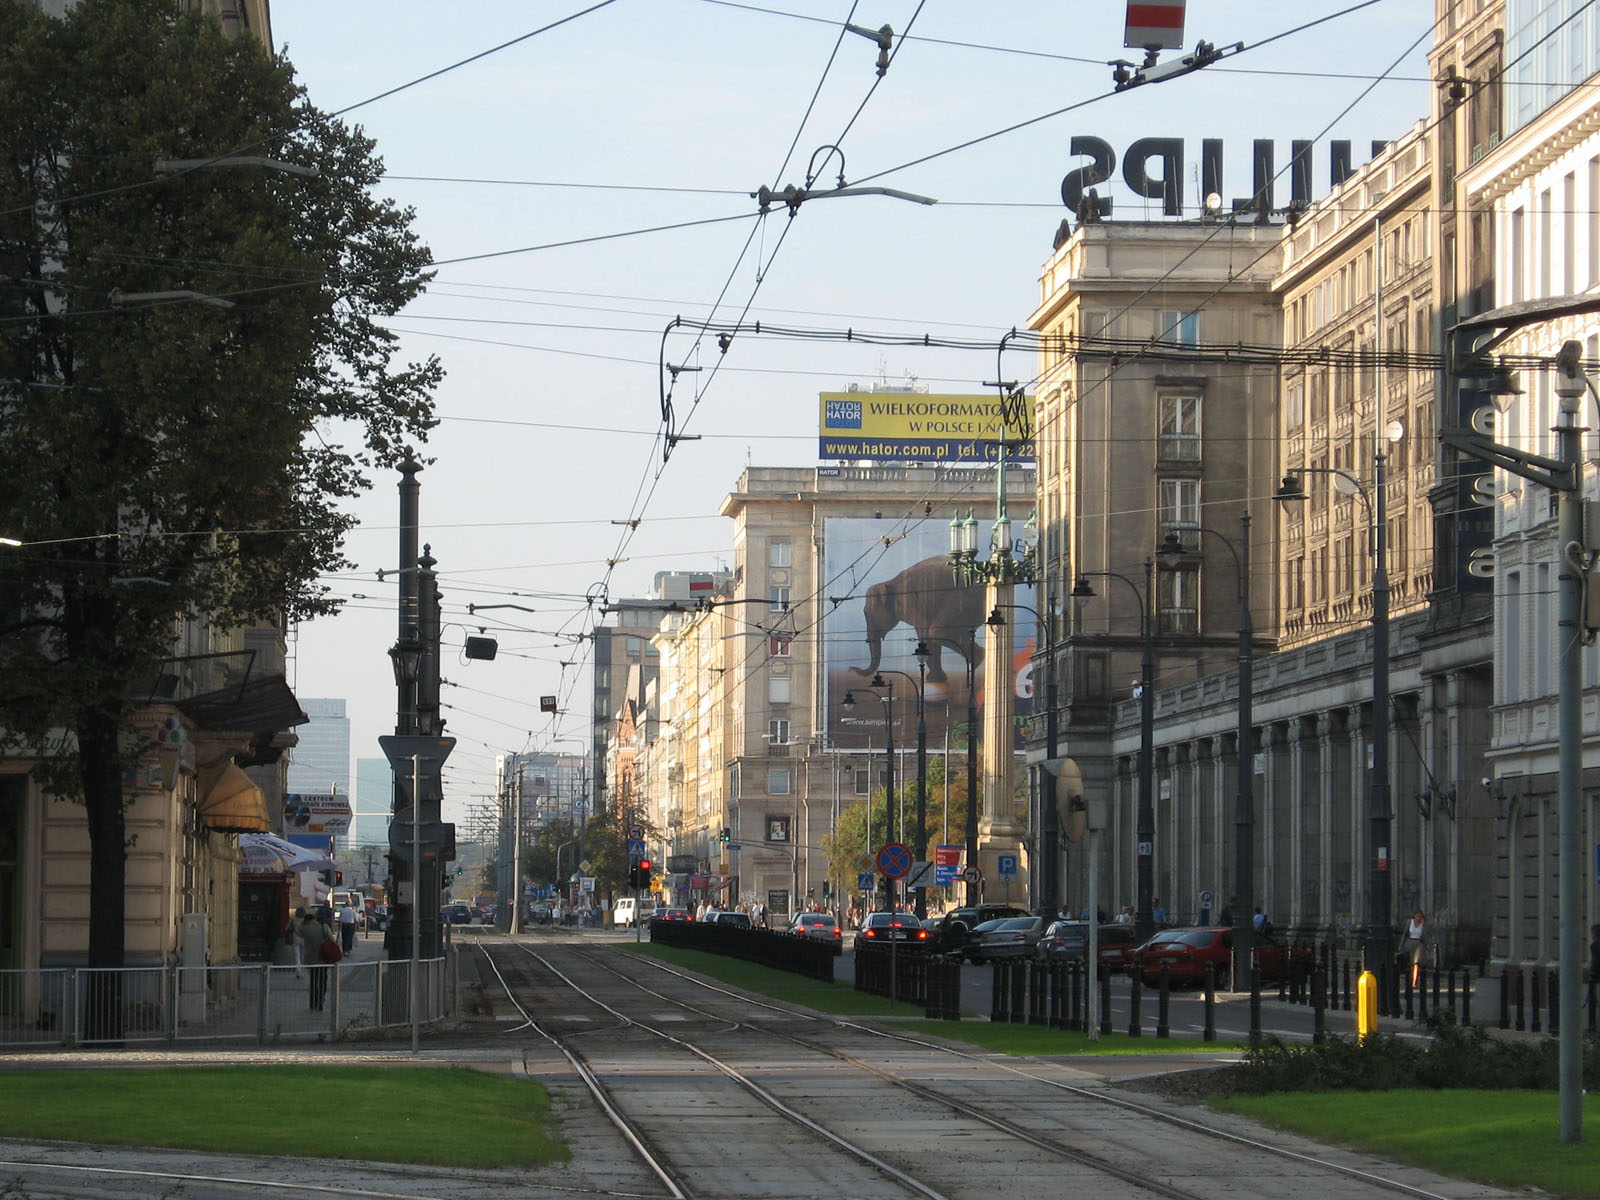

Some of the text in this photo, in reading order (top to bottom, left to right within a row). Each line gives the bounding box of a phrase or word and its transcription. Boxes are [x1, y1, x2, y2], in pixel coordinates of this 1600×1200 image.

[826, 411, 861, 419] HATOR
[909, 422, 922, 433] W
[927, 422, 974, 433] POLSCE
[826, 442, 949, 459] www.hator.com.pl
[958, 444, 980, 457] tel.
[1003, 857, 1013, 872] P
